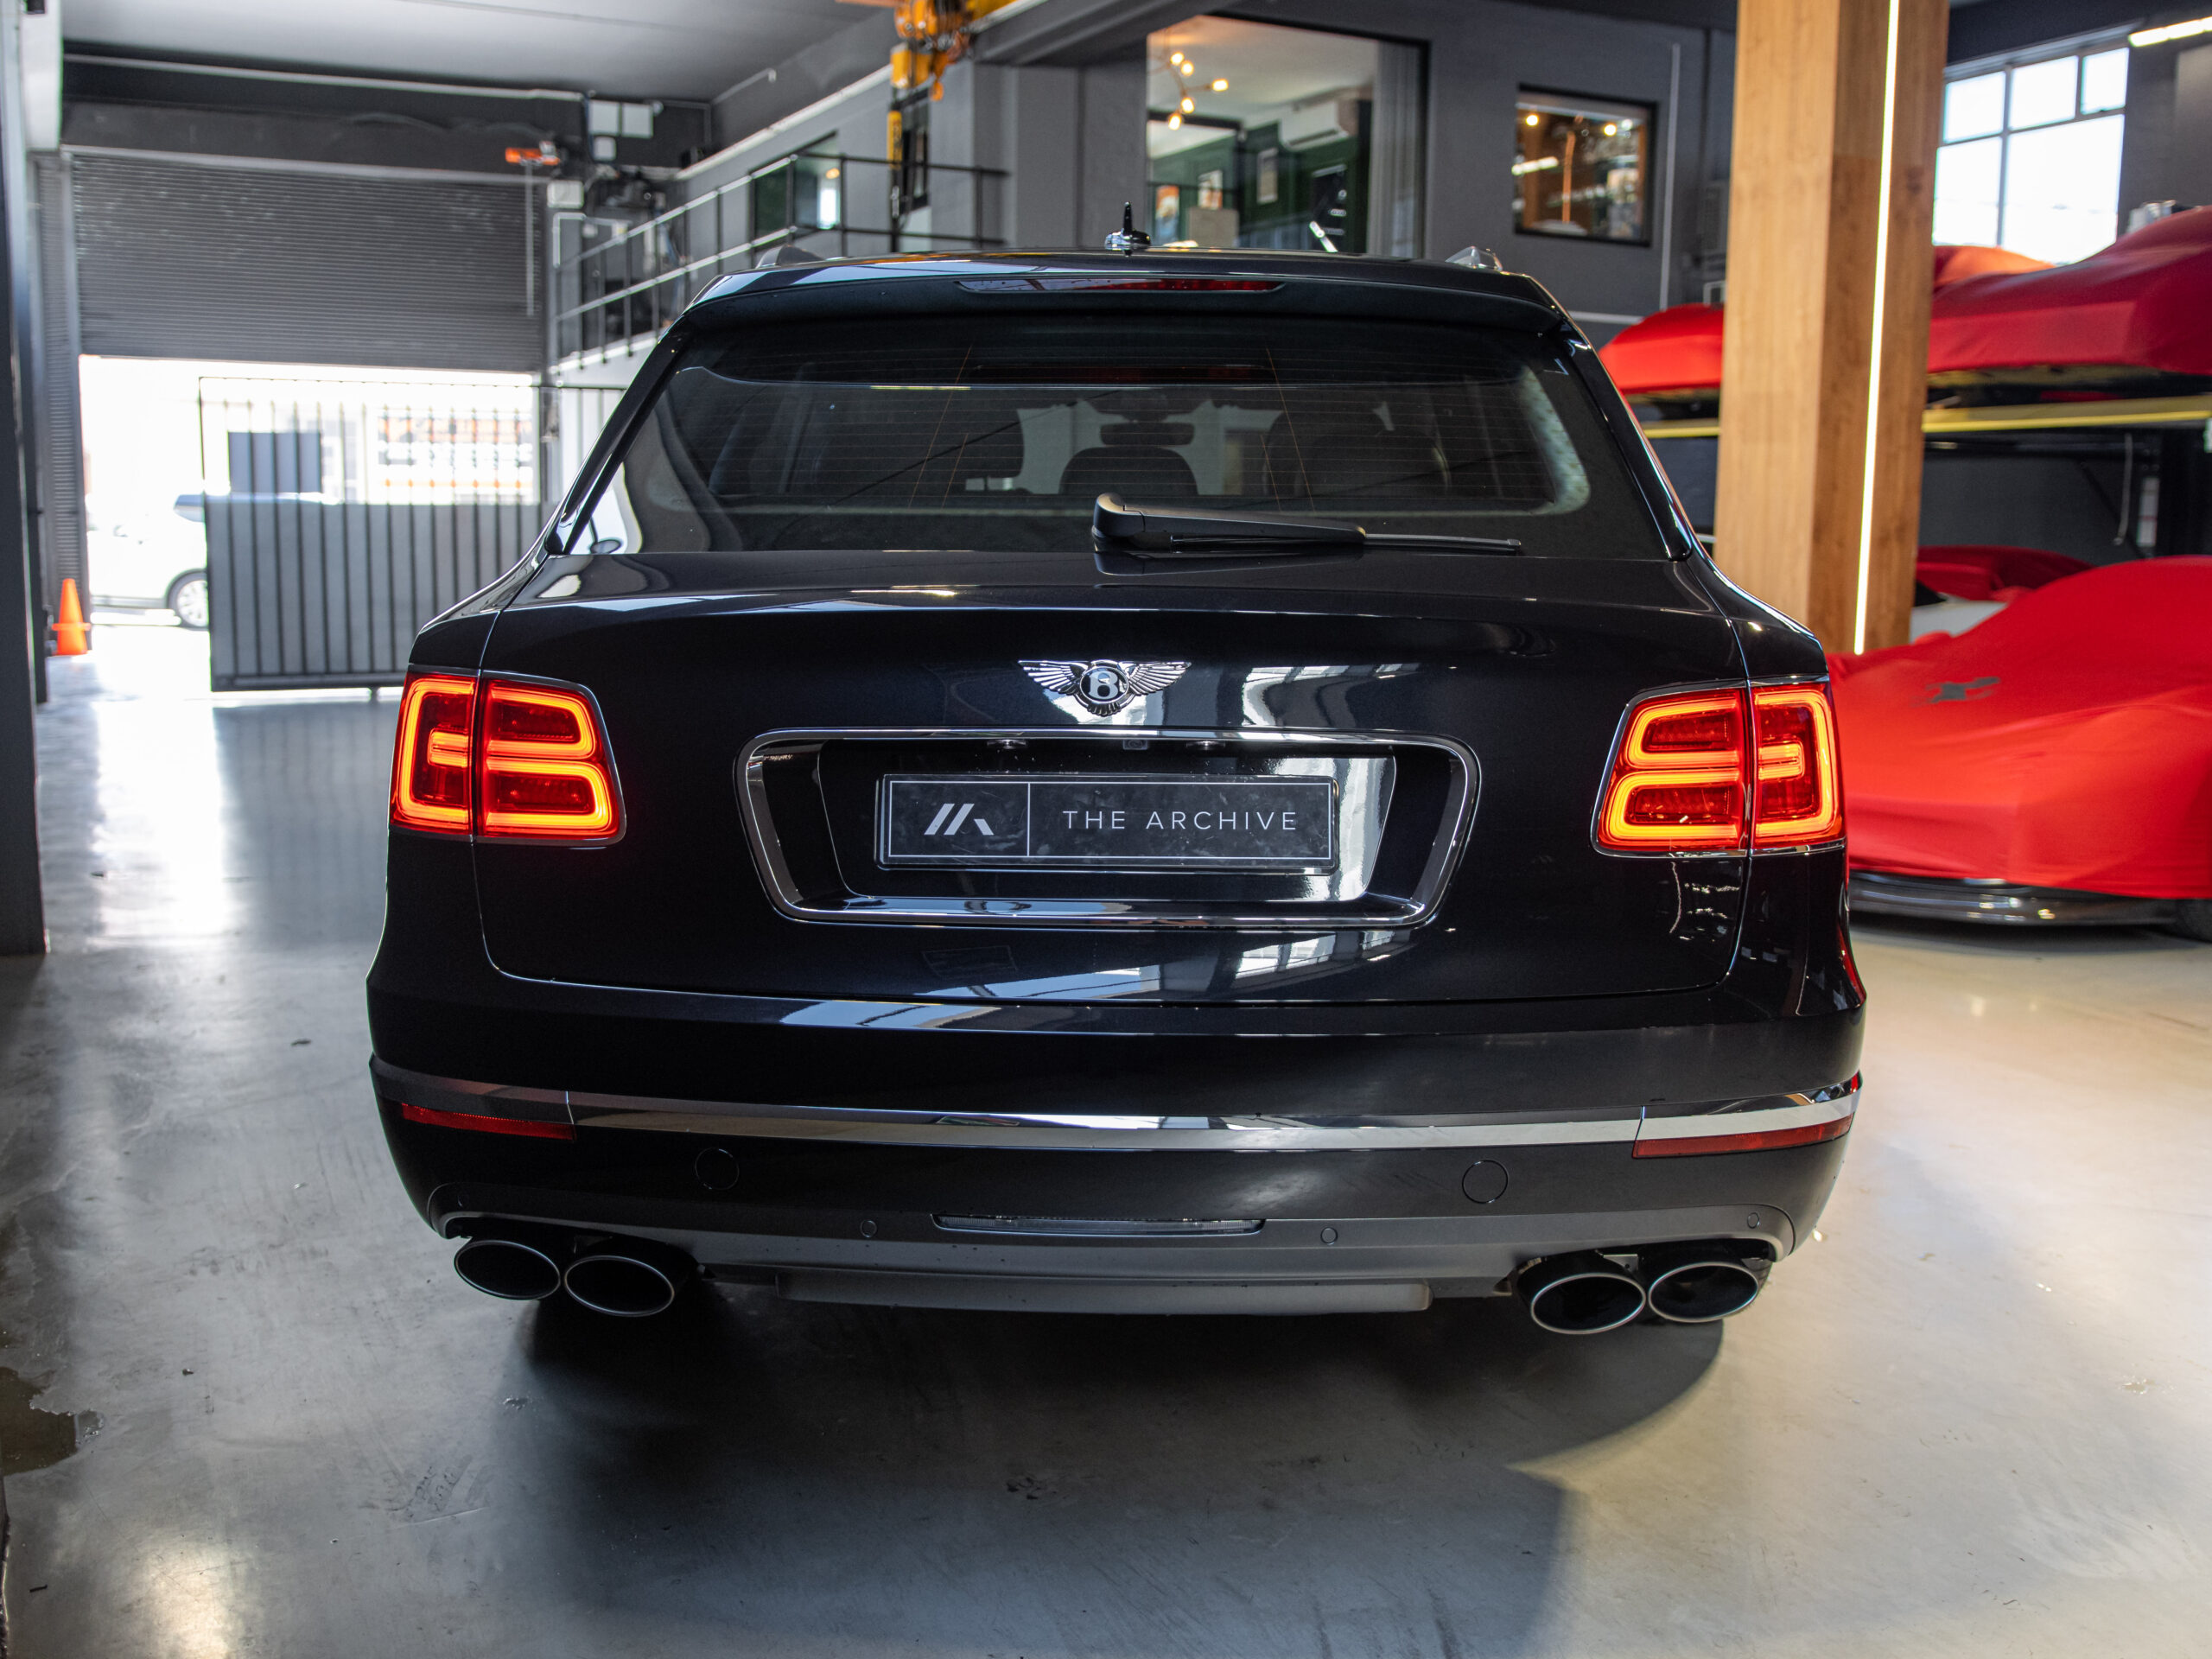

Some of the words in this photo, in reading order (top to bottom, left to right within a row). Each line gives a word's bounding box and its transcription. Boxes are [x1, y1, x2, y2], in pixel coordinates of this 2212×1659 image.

[1089, 671, 1119, 700] B
[1062, 810, 1126, 830] THE
[1145, 810, 1297, 830] ARCHIVE
